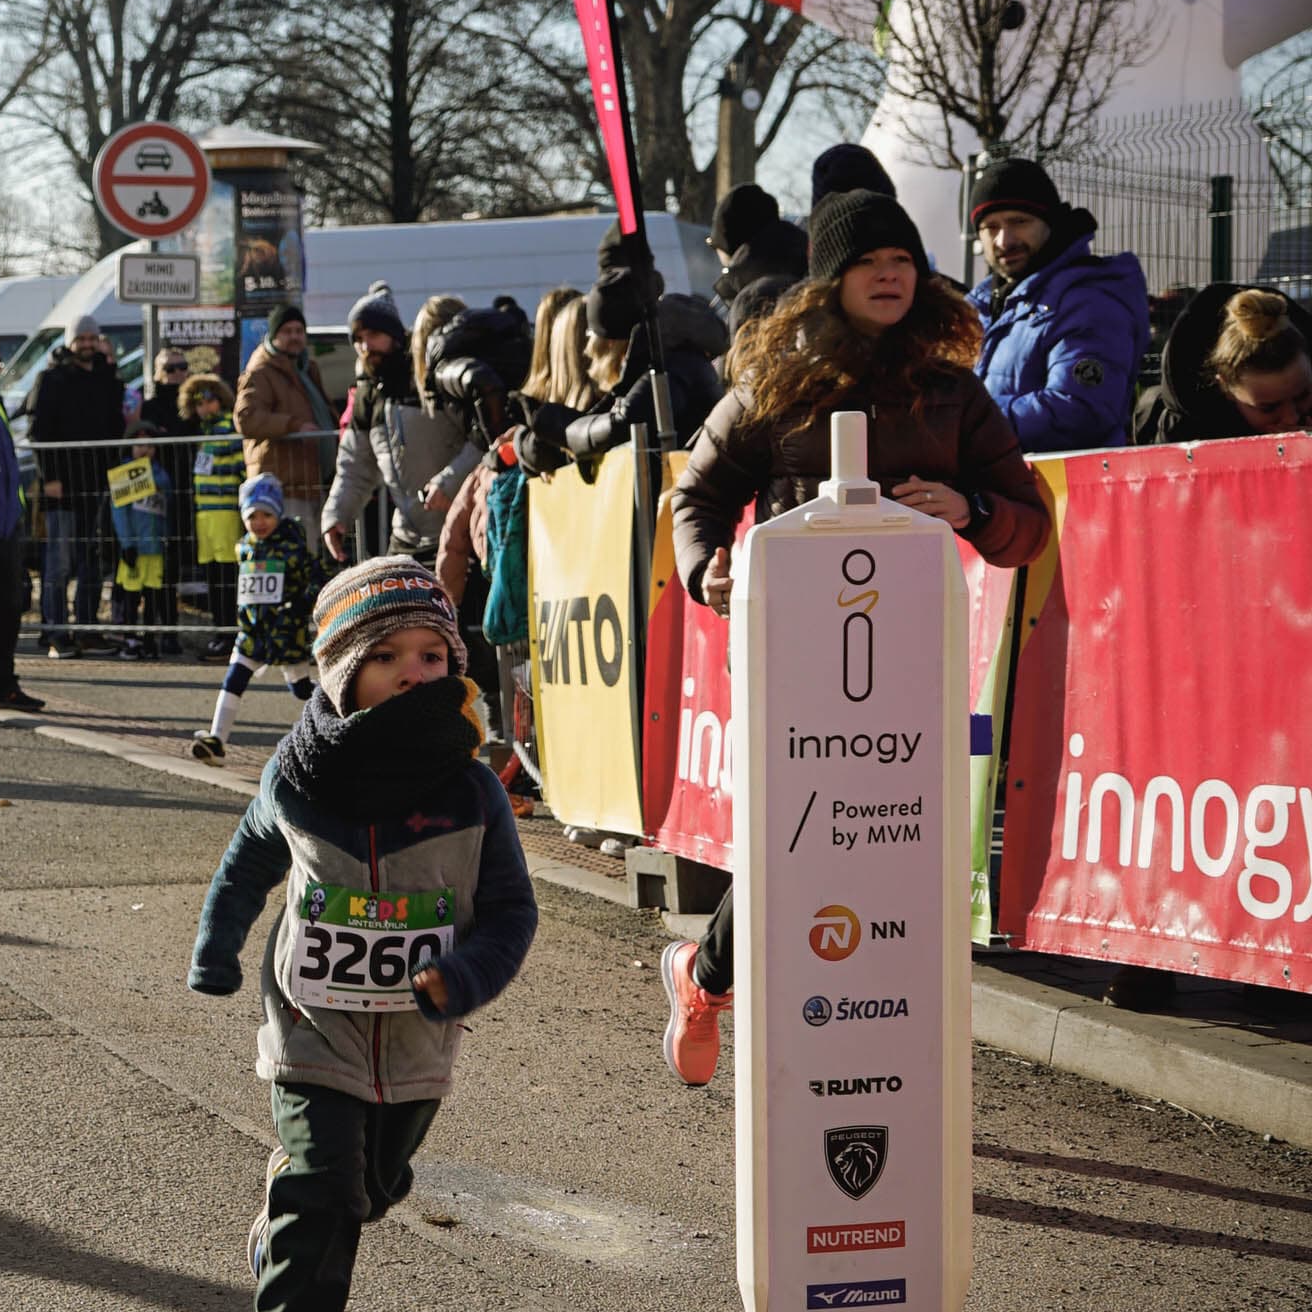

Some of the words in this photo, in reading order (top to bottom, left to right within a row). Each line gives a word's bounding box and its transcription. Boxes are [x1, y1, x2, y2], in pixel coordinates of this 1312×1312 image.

[240, 575, 277, 594] 3210
[790, 727, 922, 764] innogy
[833, 796, 922, 819] Powered
[833, 826, 858, 851] by
[868, 824, 921, 844] MVM
[871, 920, 906, 940] NN
[299, 926, 441, 987] 3260
[836, 998, 909, 1021] ŠKODA
[827, 1075, 903, 1096] RUNTO
[830, 1132, 883, 1143] PEUGEOT
[812, 1227, 901, 1249] NUTREND
